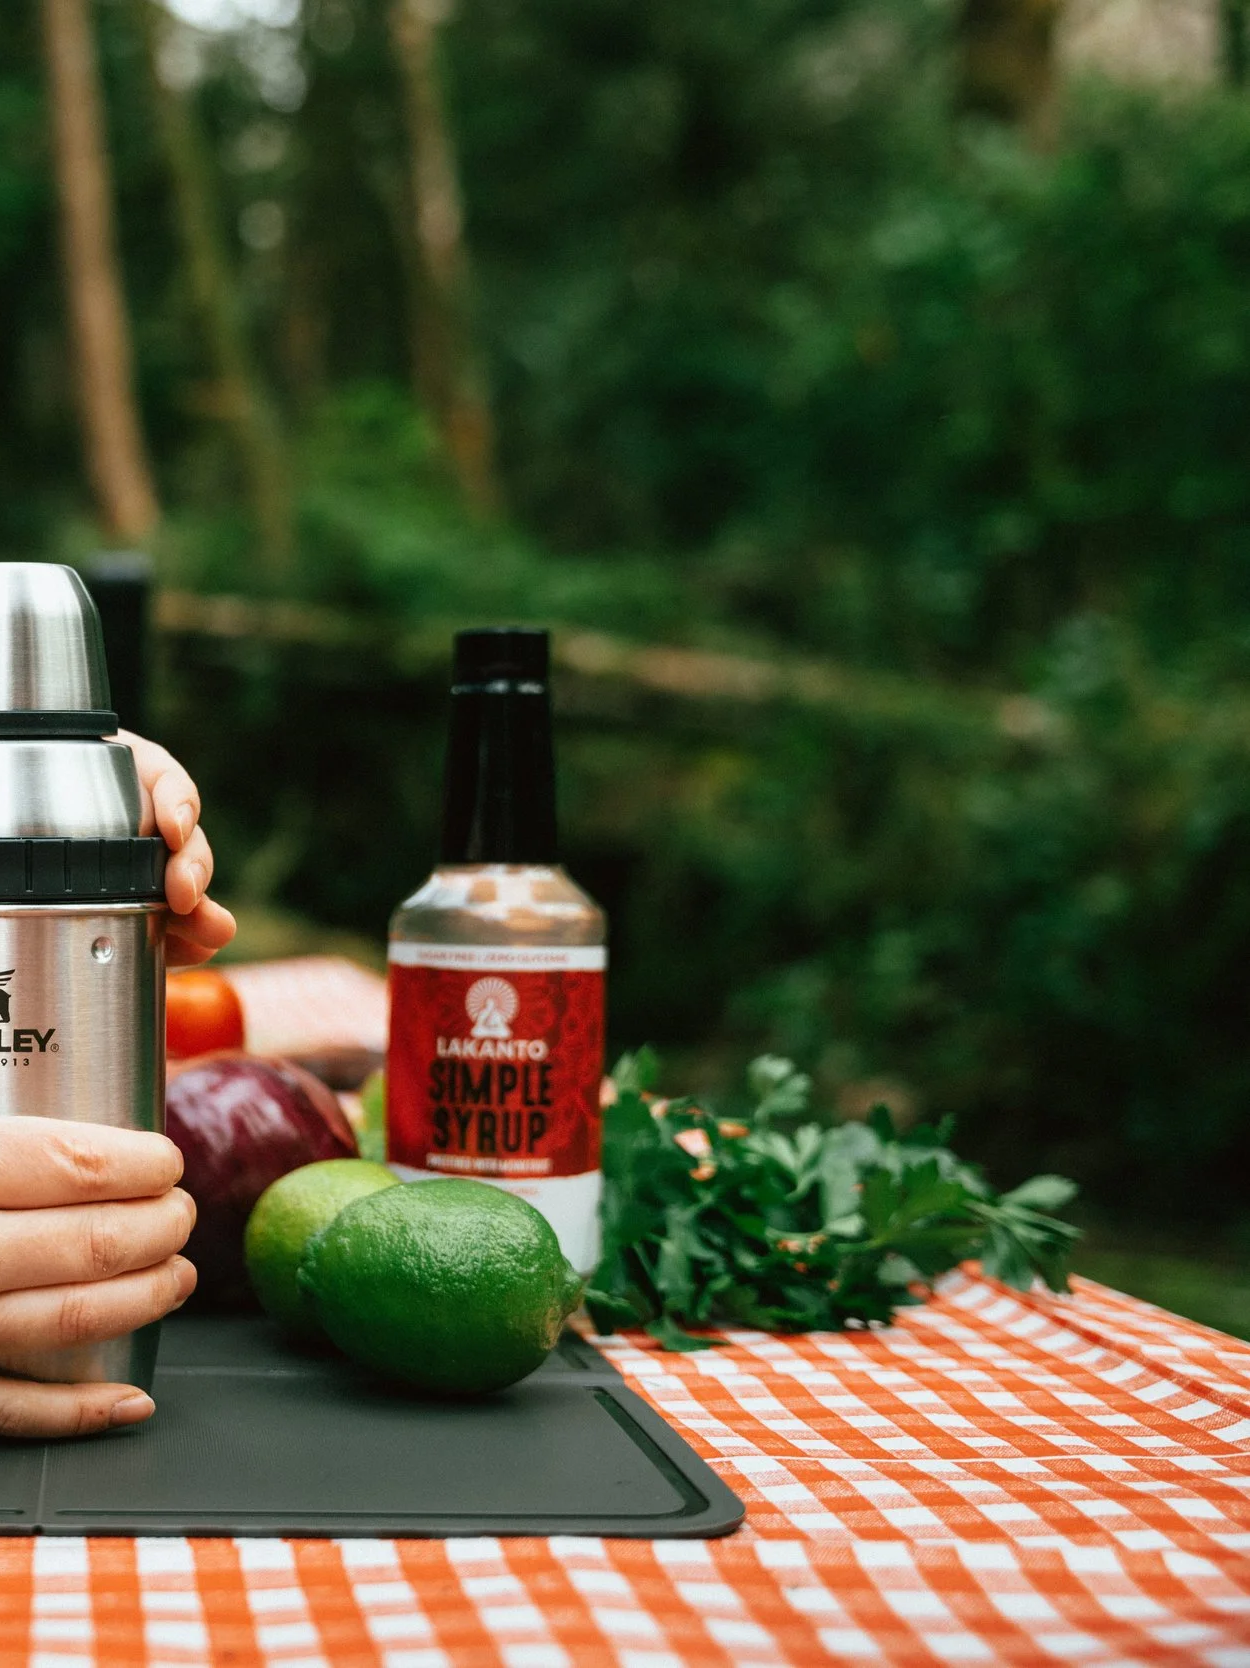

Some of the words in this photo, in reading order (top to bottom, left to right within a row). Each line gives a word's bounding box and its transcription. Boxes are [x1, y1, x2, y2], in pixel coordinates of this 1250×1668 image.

[436, 1037, 548, 1061] LAKANTO
[430, 1060, 554, 1106] SIMPLE
[433, 1107, 548, 1153] SYRUP
